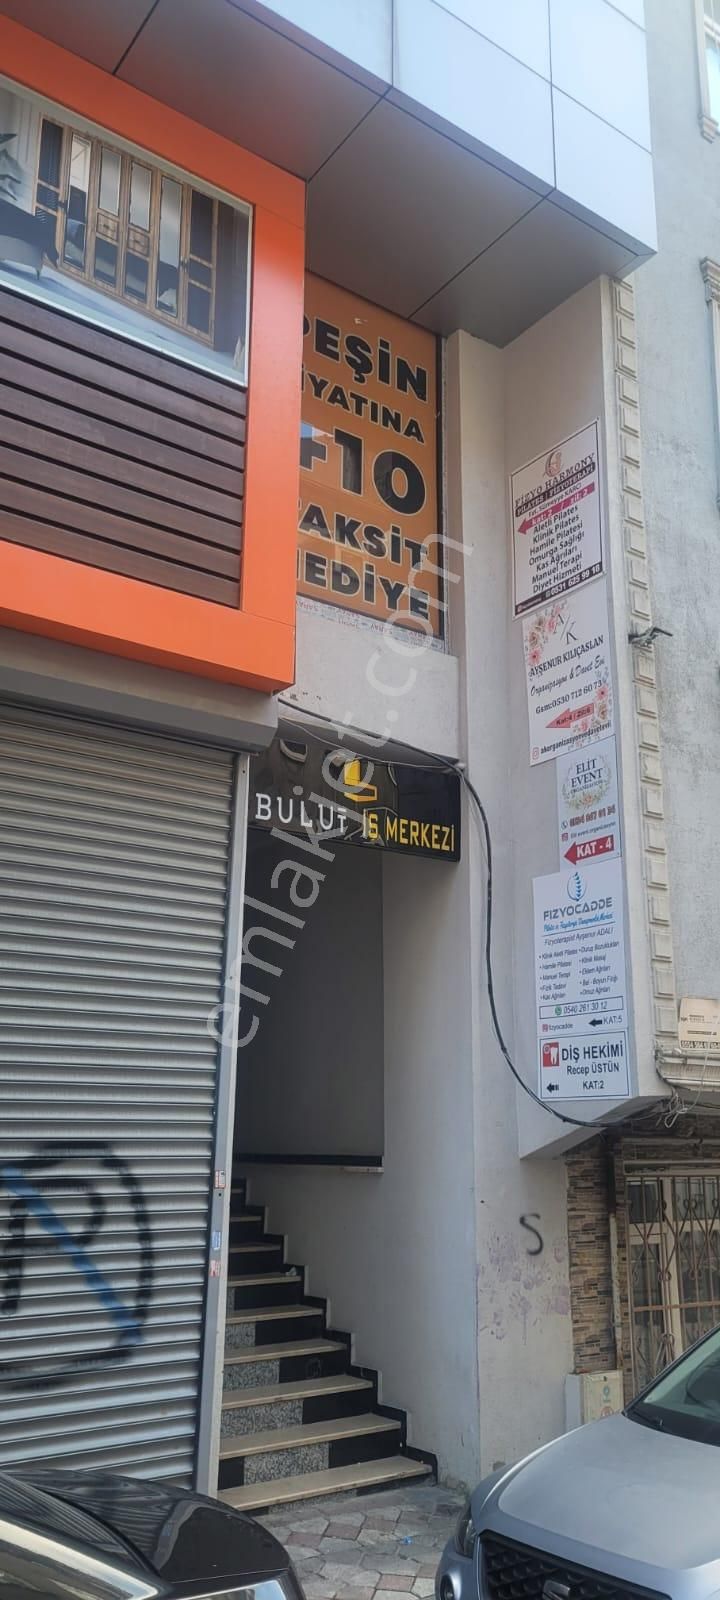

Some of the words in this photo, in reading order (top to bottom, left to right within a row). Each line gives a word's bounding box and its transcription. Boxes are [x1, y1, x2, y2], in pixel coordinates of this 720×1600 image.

[302, 313, 427, 403] EŞİN
[545, 453, 594, 489] HARMONY
[533, 517, 552, 534] Aletli
[553, 502, 578, 523] Pilates
[533, 526, 553, 544] Klinik
[555, 512, 578, 532] Pilates
[298, 497, 427, 573] AKSİT
[529, 544, 557, 567] Omurga
[559, 530, 584, 551] Sağlığı
[530, 536, 554, 556] Hamile
[557, 519, 582, 540] Pilatesi
[532, 563, 558, 584] Manuel
[559, 551, 582, 570] Terapi
[536, 558, 548, 572] Kas
[550, 543, 576, 566] Ağrıları
[297, 549, 429, 619] EDİYE
[533, 576, 552, 594] Diyet
[553, 561, 581, 582] Hizmeti
[530, 655, 562, 676] AYŞENUR
[563, 634, 604, 660] KILIÇASLAN
[535, 694, 570, 714] Gsm:0530
[571, 688, 582, 700] 712
[571, 768, 603, 788] EVENT
[255, 792, 349, 833] BULUT
[386, 815, 455, 853] MERKEZİ
[576, 842, 597, 858] KAT
[605, 836, 611, 849] 4
[591, 1001, 598, 1010] 30
[600, 1000, 607, 1008] 12
[562, 1045, 580, 1063] DİŞ
[583, 1040, 624, 1060] HEKİMİ
[566, 1065, 590, 1076] Recep
[591, 1060, 620, 1074] ÜSTÜN
[582, 1080, 605, 1090] KAT:2
